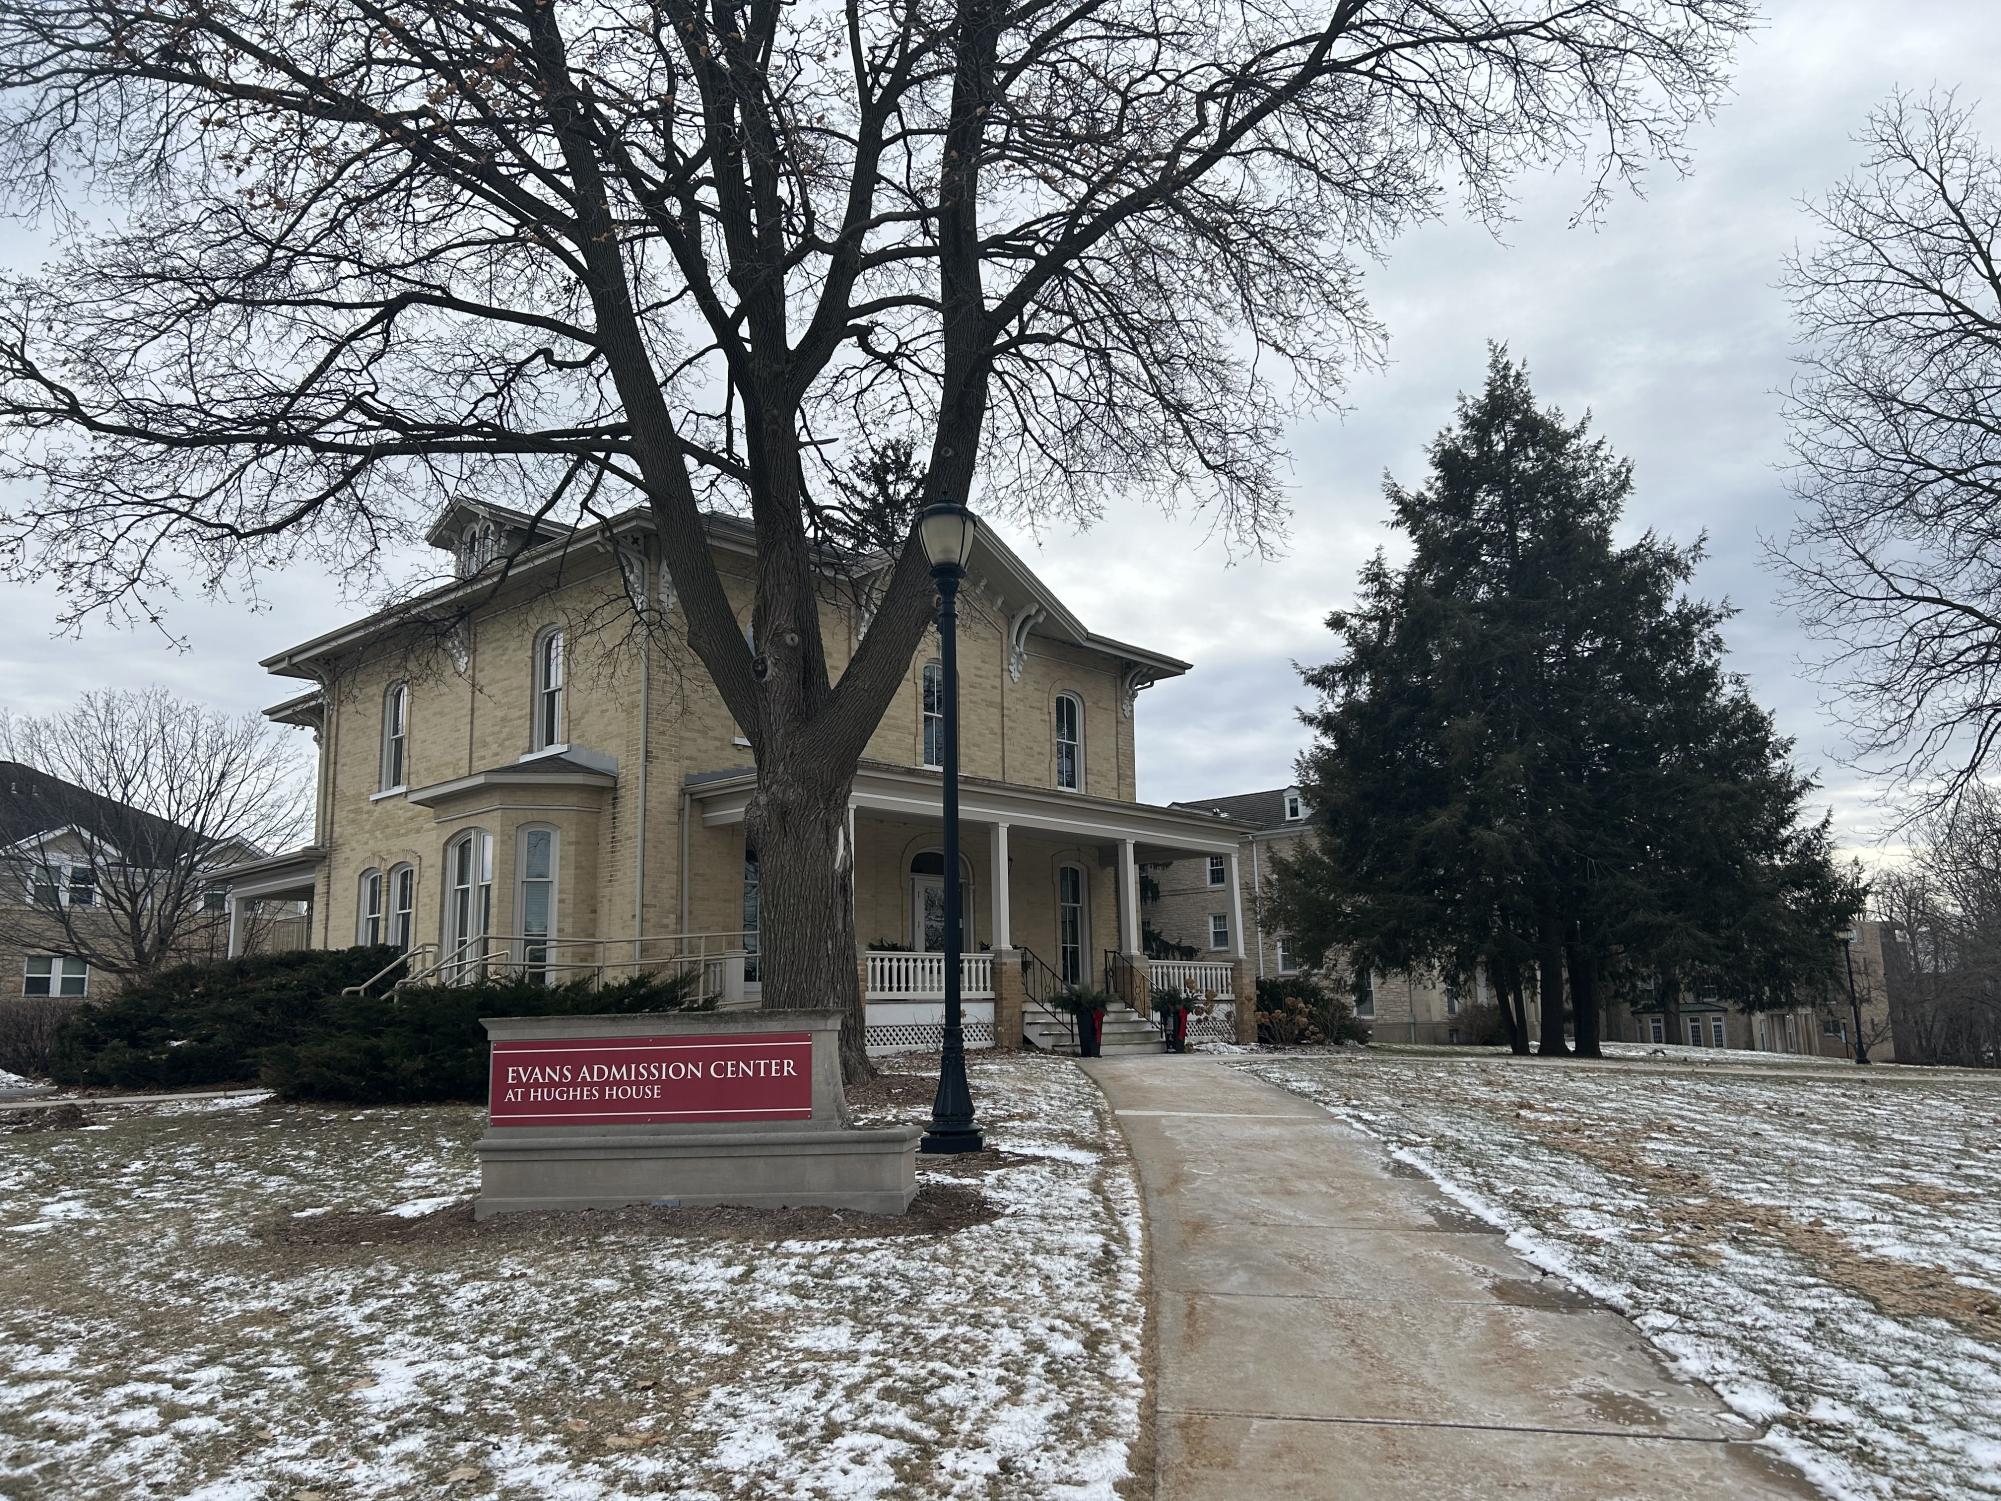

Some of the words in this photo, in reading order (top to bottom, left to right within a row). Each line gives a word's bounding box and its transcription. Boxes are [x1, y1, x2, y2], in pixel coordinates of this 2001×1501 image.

[506, 1065, 572, 1084] EVANS
[577, 1062, 703, 1082] ADMISSION
[709, 1059, 798, 1079] CENTER
[504, 1088, 526, 1102] AT
[529, 1086, 600, 1102] HUGHES
[604, 1085, 662, 1100] HOUSE
